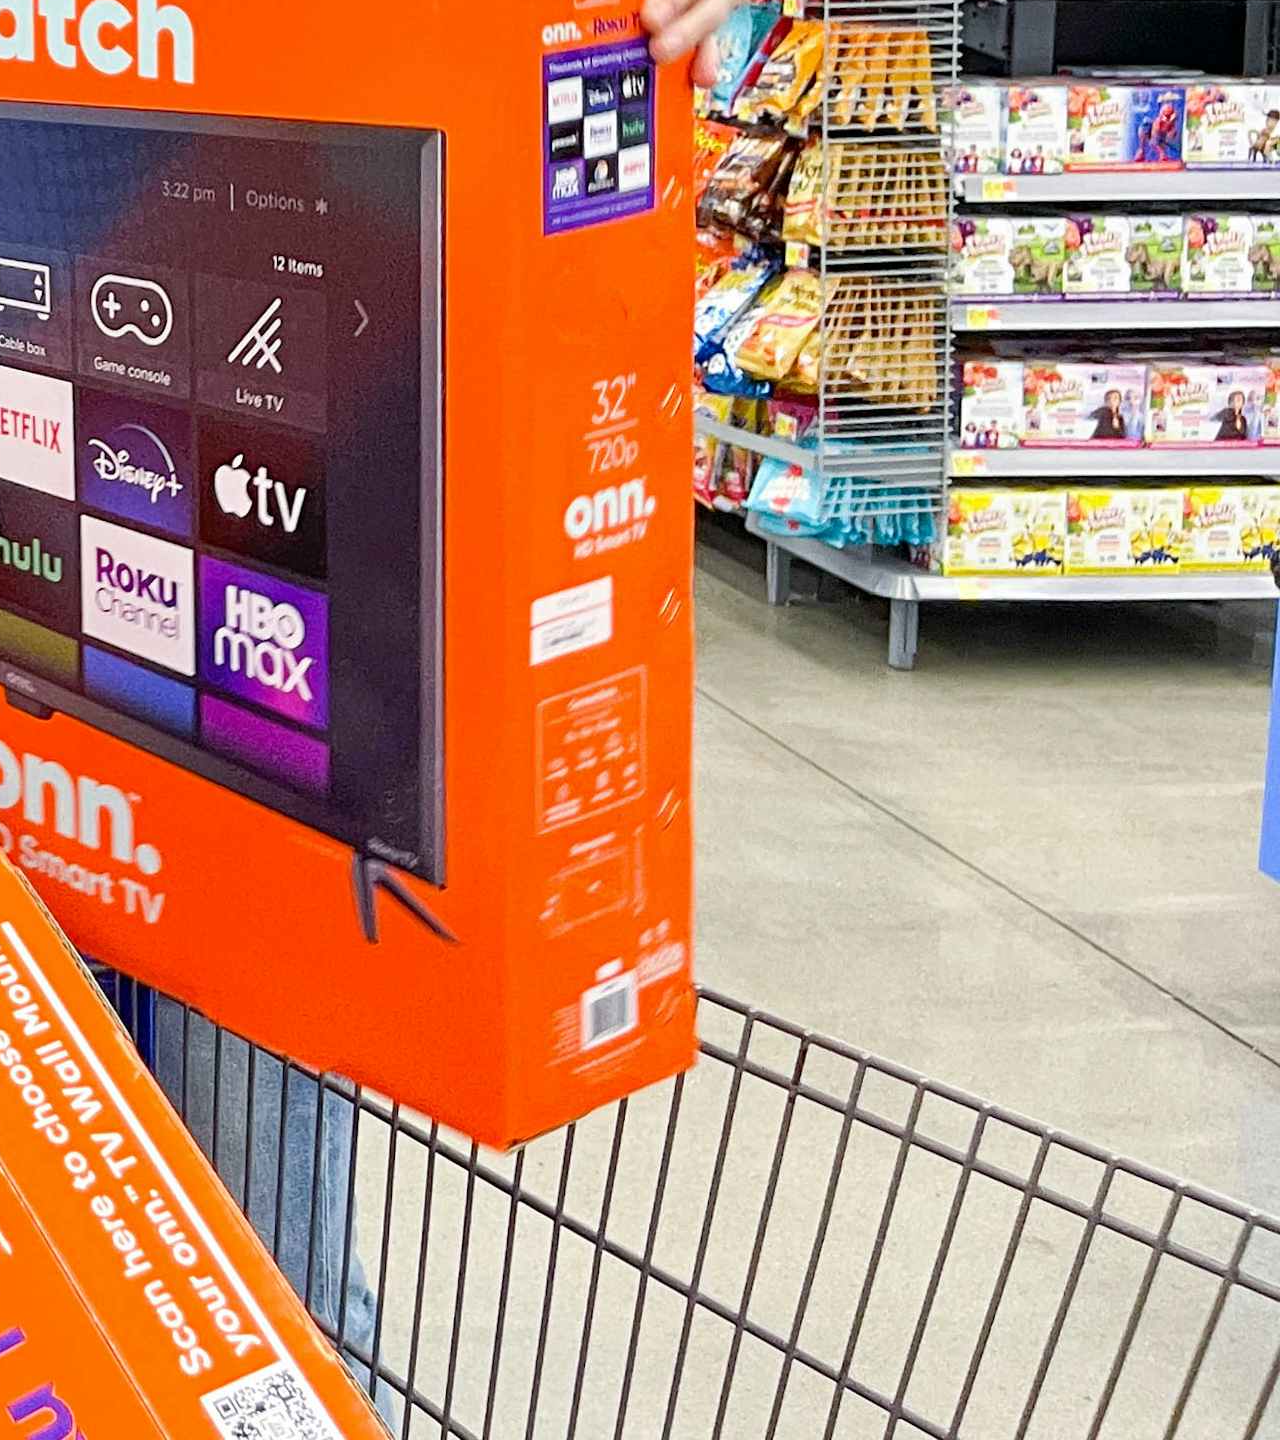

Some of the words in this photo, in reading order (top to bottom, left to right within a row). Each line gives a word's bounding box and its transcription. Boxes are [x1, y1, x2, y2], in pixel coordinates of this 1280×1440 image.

[161, 180, 190, 201] 3:22
[193, 187, 217, 206] pm
[245, 189, 305, 215] Options
[272, 254, 285, 273] 12
[24, 338, 47, 358] box
[93, 354, 127, 378] Game
[128, 362, 172, 388] console
[234, 388, 260, 410] Live
[260, 393, 285, 414] TV
[587, 433, 639, 474] 720p
[563, 474, 657, 541] onn.
[93, 587, 182, 643] Channel
[224, 584, 307, 650] HBO
[15, 835, 116, 902] Smart
[119, 874, 166, 926] TV
[36, 1039, 108, 1126] Wall
[64, 1148, 107, 1196] to
[89, 1126, 141, 1184] TV
[90, 1193, 152, 1280] here
[146, 1277, 213, 1377] Scan
[190, 1275, 264, 1359] your
